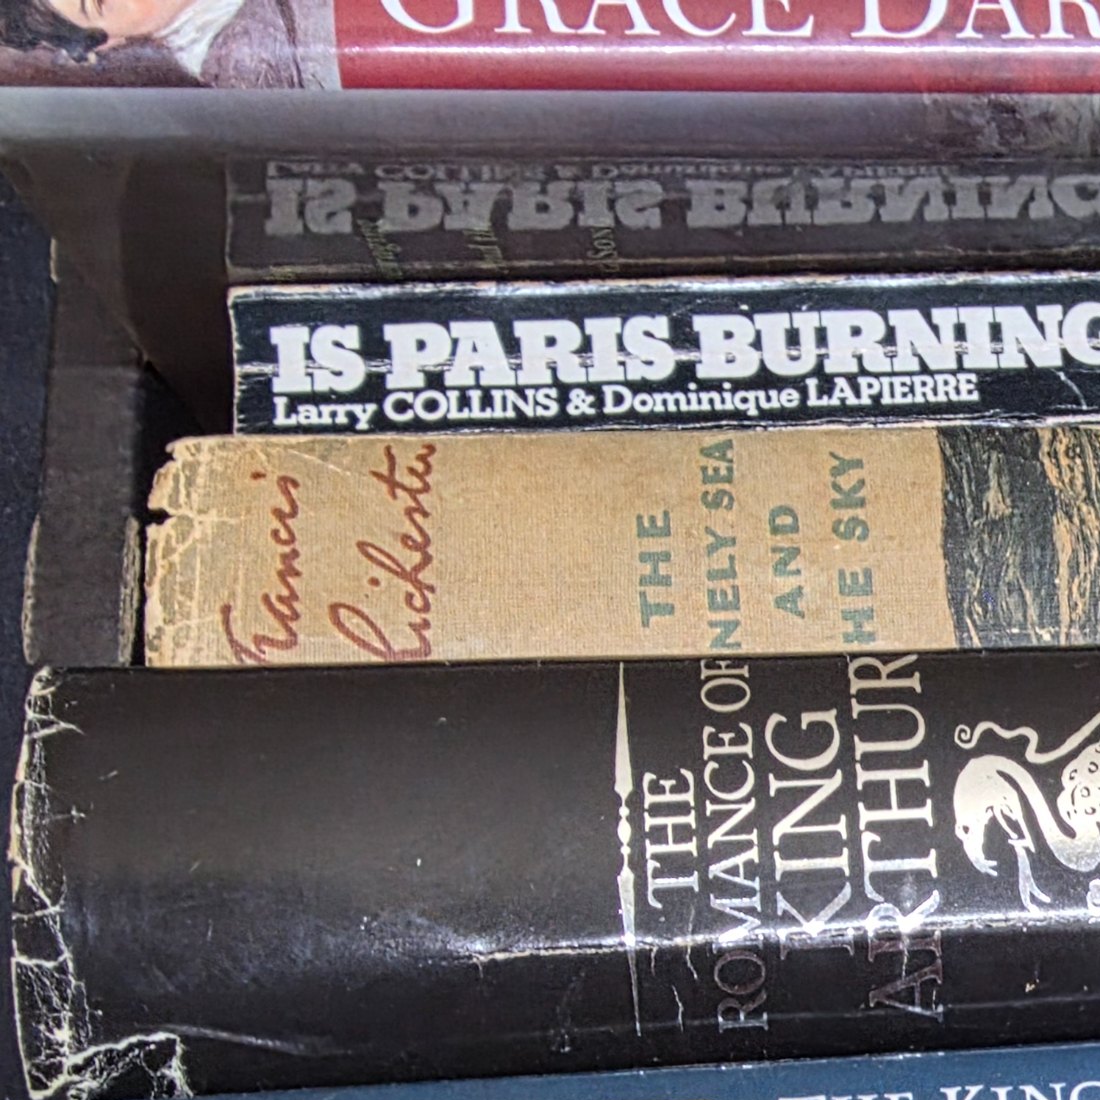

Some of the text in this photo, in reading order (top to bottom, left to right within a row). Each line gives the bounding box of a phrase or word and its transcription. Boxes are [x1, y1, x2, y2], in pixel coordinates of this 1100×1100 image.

[270, 325, 365, 393] IS
[384, 314, 677, 390] PARIS
[274, 372, 980, 431] Larry COLLINS & Dominique LAPIERRE
[636, 509, 675, 628] THE
[700, 438, 743, 650] NELY SEA
[768, 505, 805, 619] AND
[829, 451, 877, 643] HE SKY
[642, 767, 700, 909] THE
[699, 659, 770, 1034] ROMANCE OF
[764, 707, 856, 960] KING
[847, 653, 945, 1023] ARTHUR
